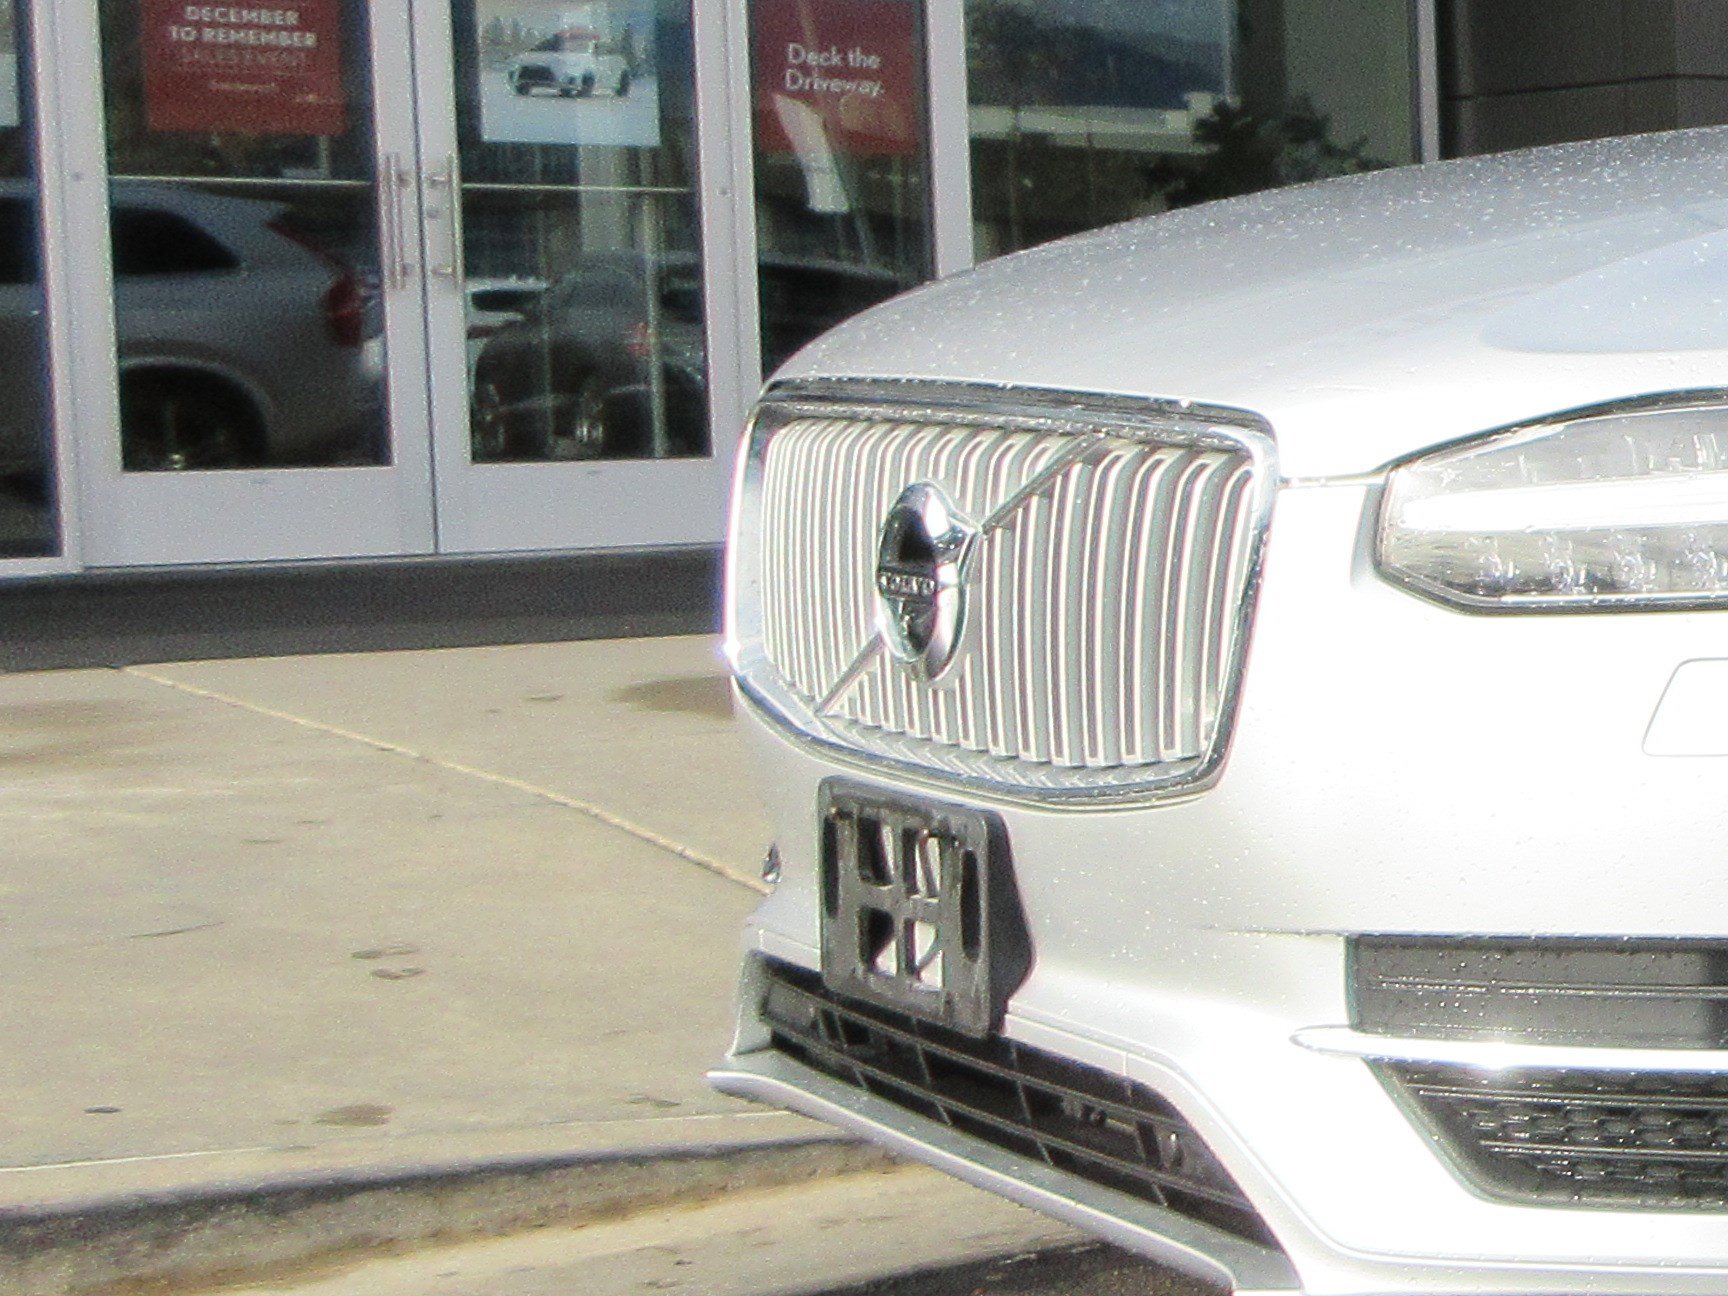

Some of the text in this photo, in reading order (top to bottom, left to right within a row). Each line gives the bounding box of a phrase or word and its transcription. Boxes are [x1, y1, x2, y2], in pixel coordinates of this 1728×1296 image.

[185, 5, 300, 25] DECEMBER
[168, 25, 317, 48] TO REMEMBER
[787, 43, 881, 68] Deck the
[785, 68, 885, 96] Driveway.
[879, 572, 936, 596] VOLVO
